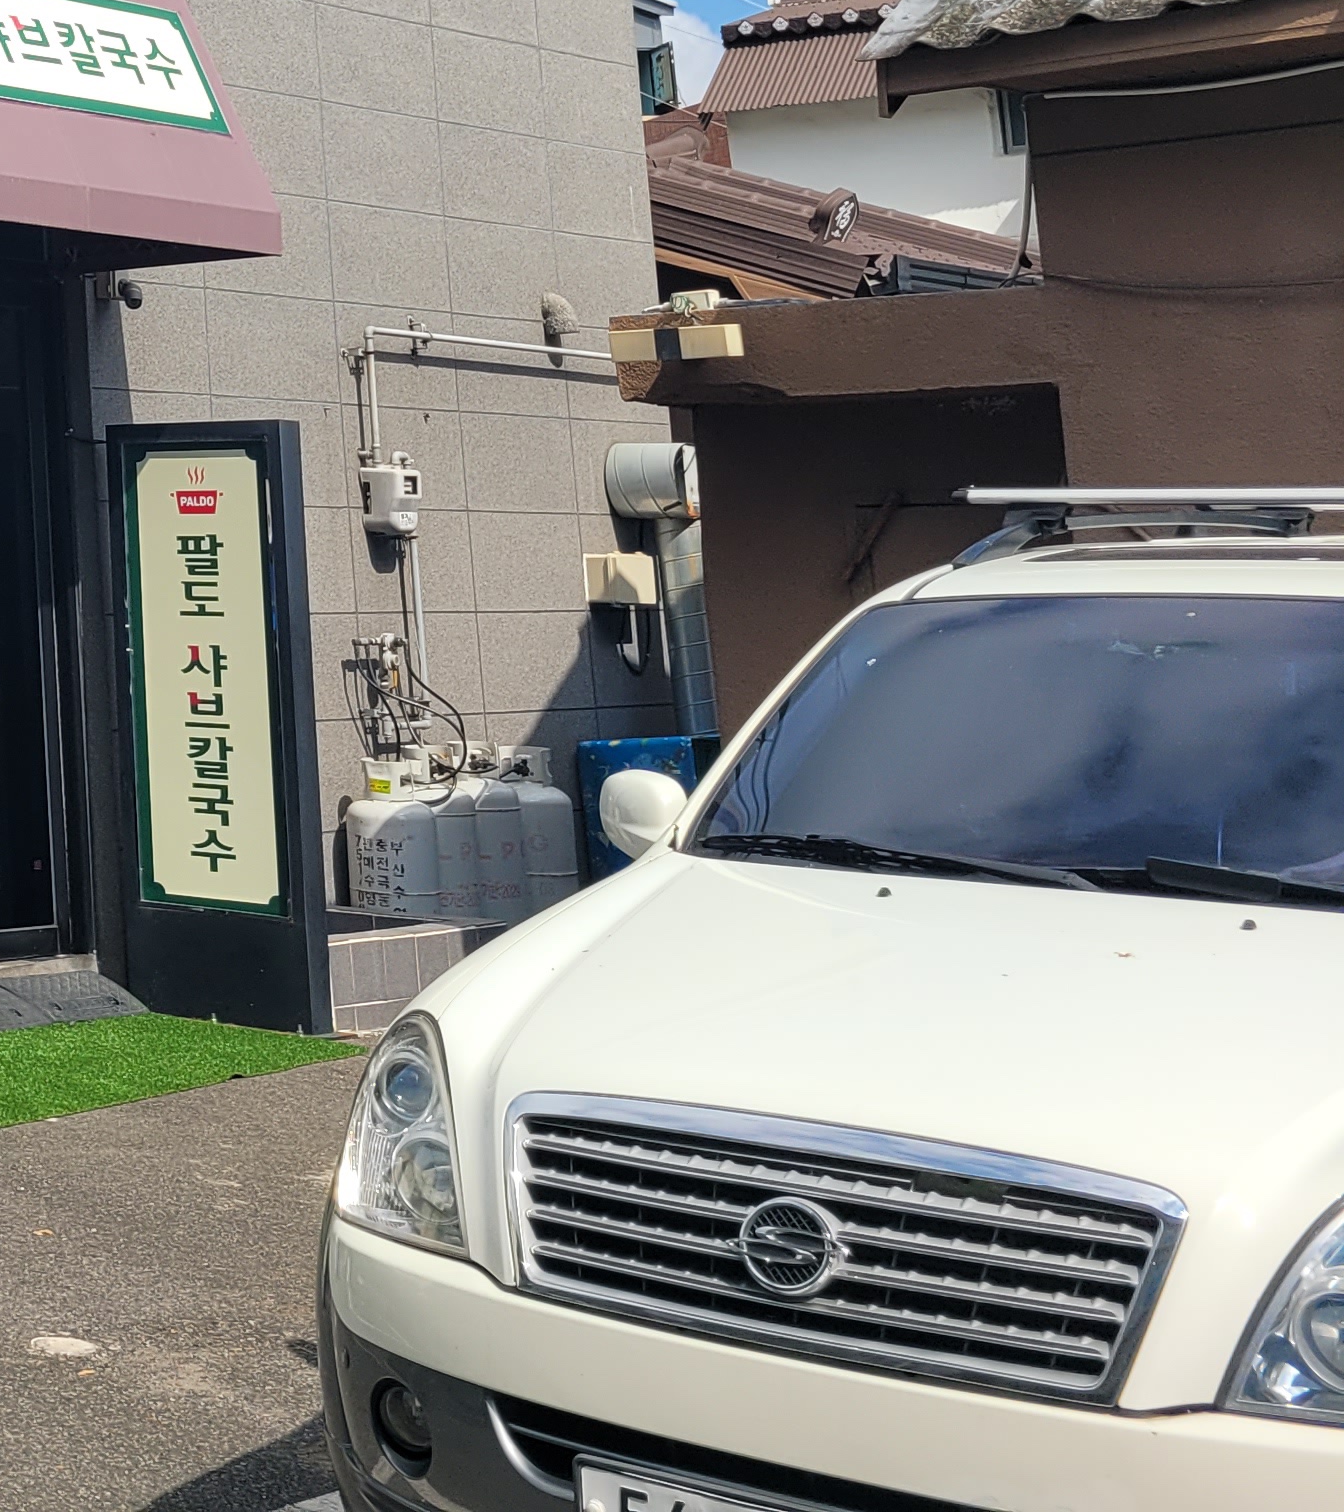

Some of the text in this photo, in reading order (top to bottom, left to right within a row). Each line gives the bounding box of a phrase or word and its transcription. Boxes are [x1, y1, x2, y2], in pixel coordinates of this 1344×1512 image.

[179, 496, 215, 508] PALDO
[176, 533, 237, 874] 팔도 샤브칼국수
